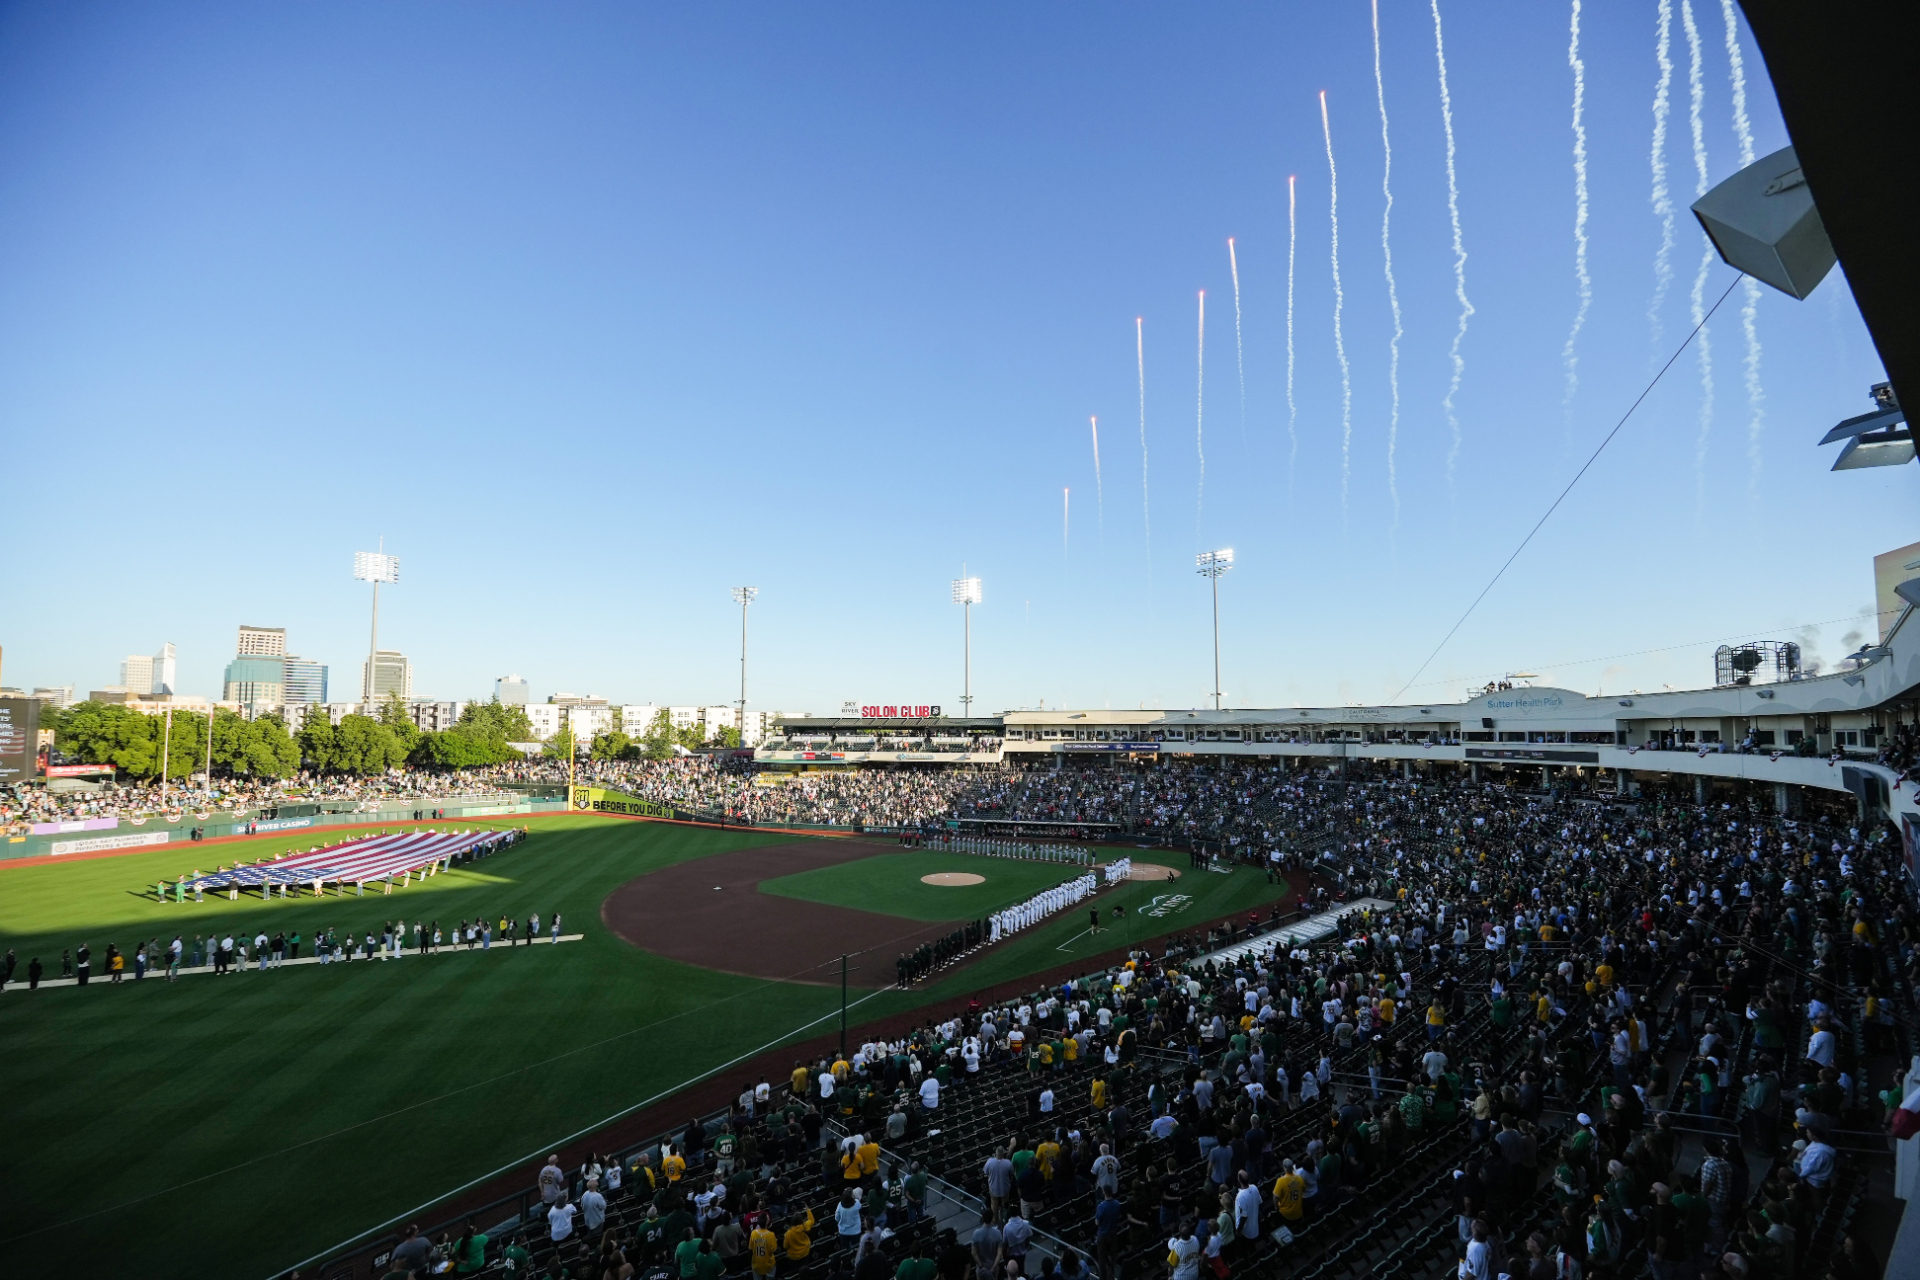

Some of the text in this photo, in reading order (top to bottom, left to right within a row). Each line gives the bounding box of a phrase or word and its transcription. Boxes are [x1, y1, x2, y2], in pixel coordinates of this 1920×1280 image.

[1487, 697, 1563, 708] Sutter Health Park
[861, 705, 930, 717] SOLON CLUB
[575, 789, 590, 801] 811
[593, 801, 663, 816] BEFORE YOU DIG
[256, 823, 280, 831] RIVER
[280, 820, 310, 828] CASINO
[899, 1096, 909, 1107] 25
[1425, 1095, 1433, 1107] 9
[720, 1143, 732, 1154] 40
[889, 1185, 901, 1196] 25
[646, 1228, 662, 1243] 24
[756, 1247, 766, 1256] 16
[505, 1257, 515, 1270] 46
